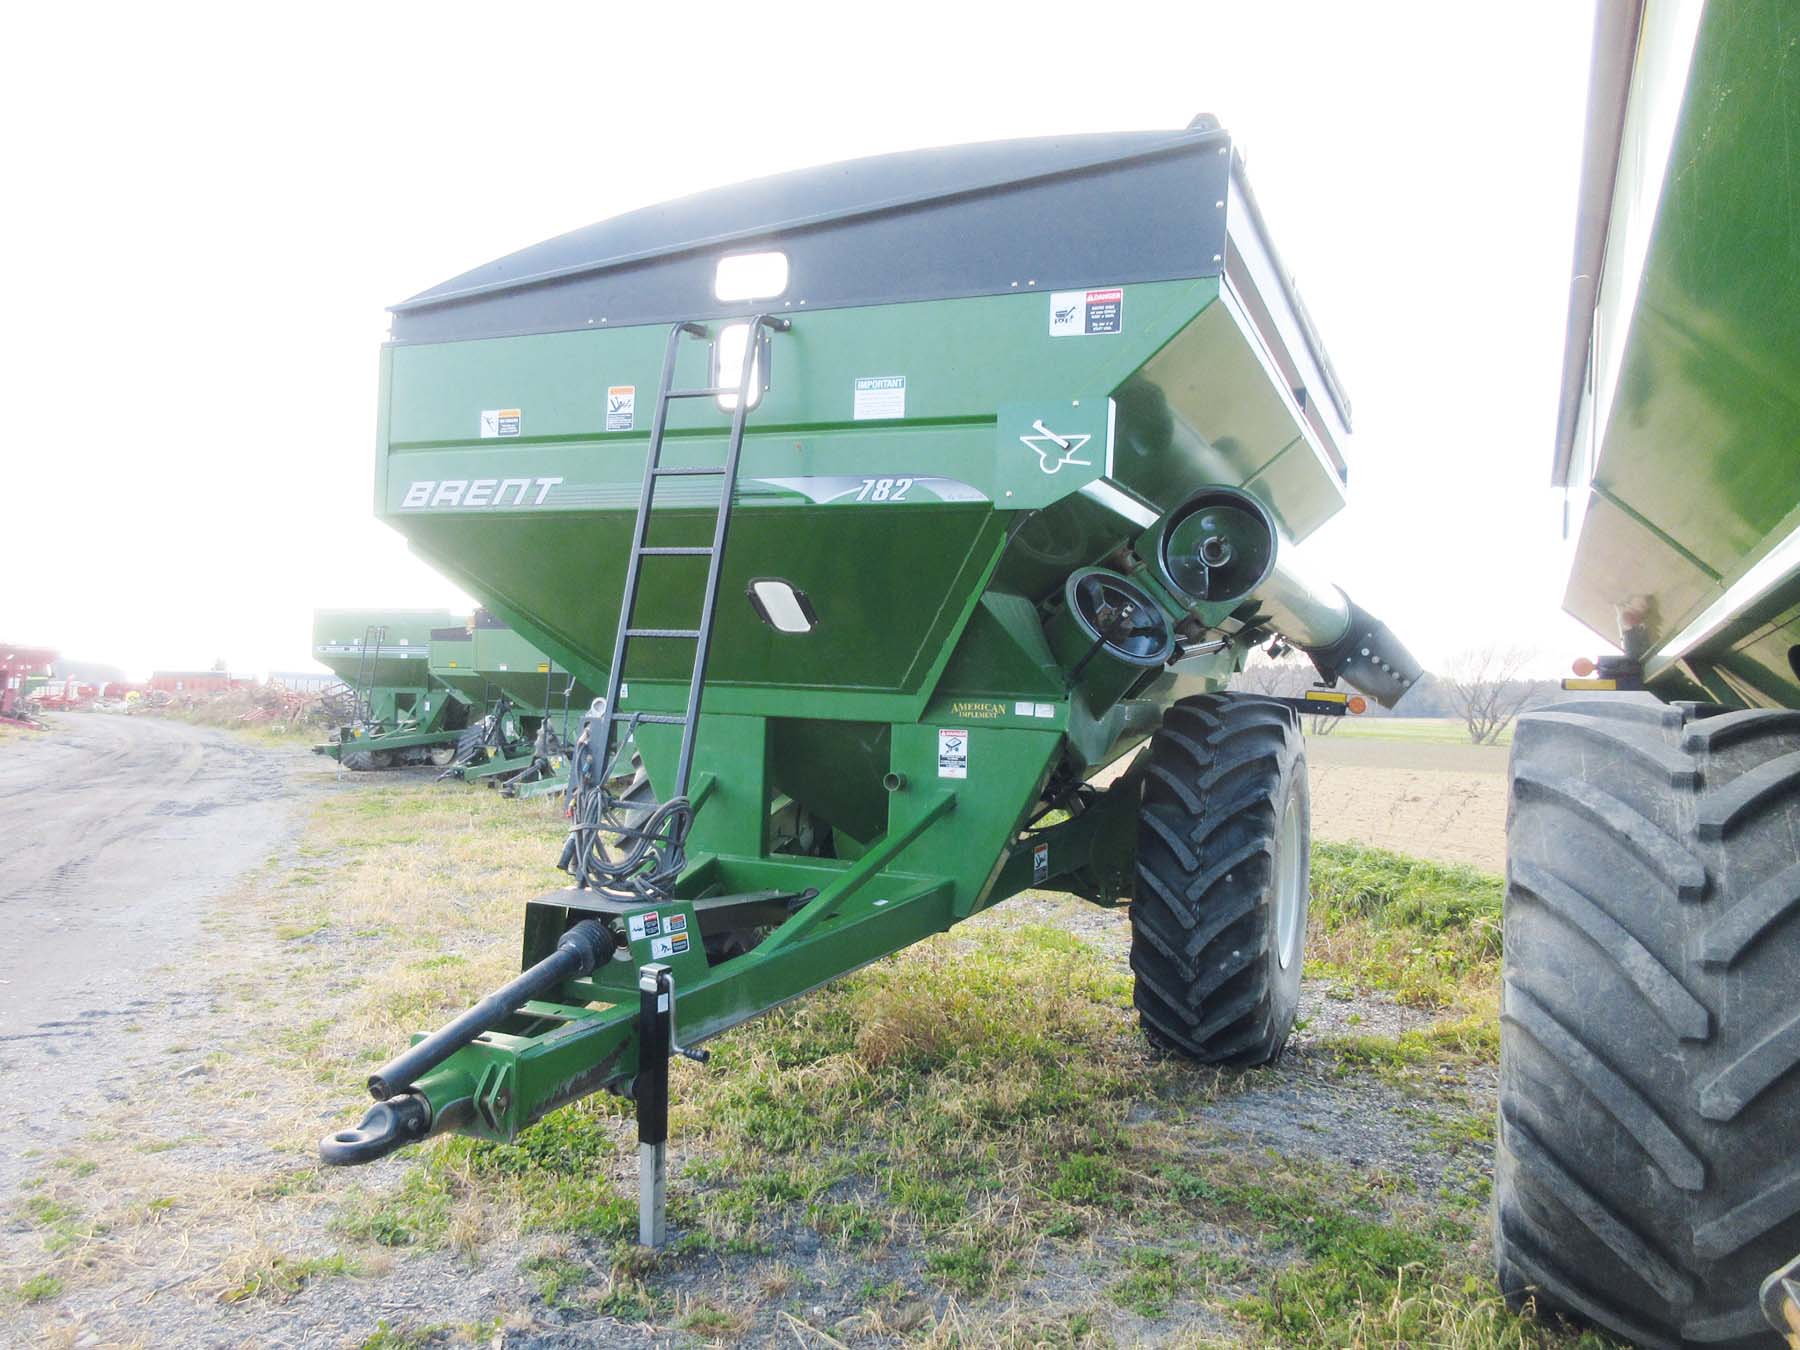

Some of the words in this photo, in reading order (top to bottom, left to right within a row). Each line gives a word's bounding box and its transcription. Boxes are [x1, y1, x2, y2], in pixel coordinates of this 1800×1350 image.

[857, 379, 902, 389] IMPORTANT
[401, 477, 563, 507] BRENT
[856, 478, 913, 501] 782
[951, 704, 1006, 715] AMERICAN
[959, 711, 998, 719] IMPLEMENT
